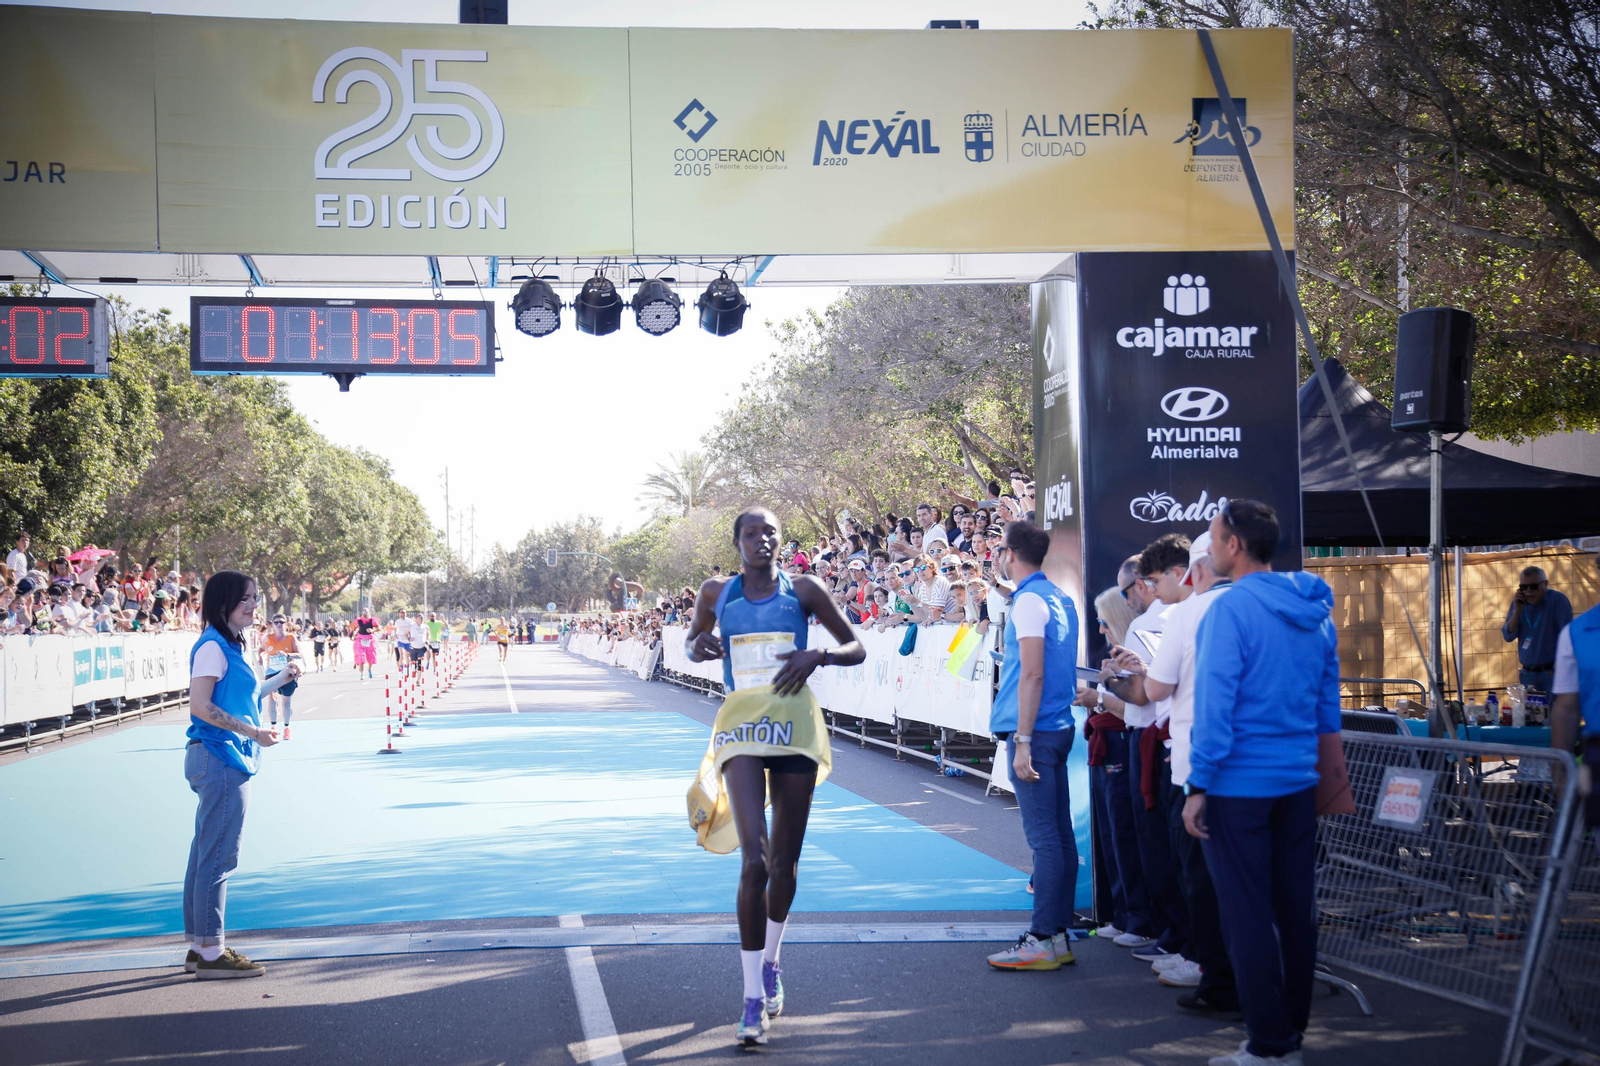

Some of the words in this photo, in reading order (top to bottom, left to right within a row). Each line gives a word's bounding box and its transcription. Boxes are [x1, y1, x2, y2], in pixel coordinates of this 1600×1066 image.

[312, 46, 505, 182] 25
[1021, 107, 1148, 137] ALMERÍA
[673, 147, 785, 162] COOPERACIÓN
[1021, 142, 1086, 157] CIUDAD
[673, 163, 712, 176] 2005
[823, 158, 848, 166] 2020
[1183, 164, 1235, 172] DEPORTES
[3, 160, 66, 184] JAR
[315, 187, 507, 229] EDICIÓN
[241, 305, 481, 365] 01:13:05
[1116, 318, 1258, 357] cajamar
[1185, 349, 1214, 358] CAJA
[1217, 349, 1255, 358] RURAL
[1147, 427, 1241, 442] HYUNDAI
[1150, 445, 1239, 459] Almerialva
[751, 643, 778, 661] 16
